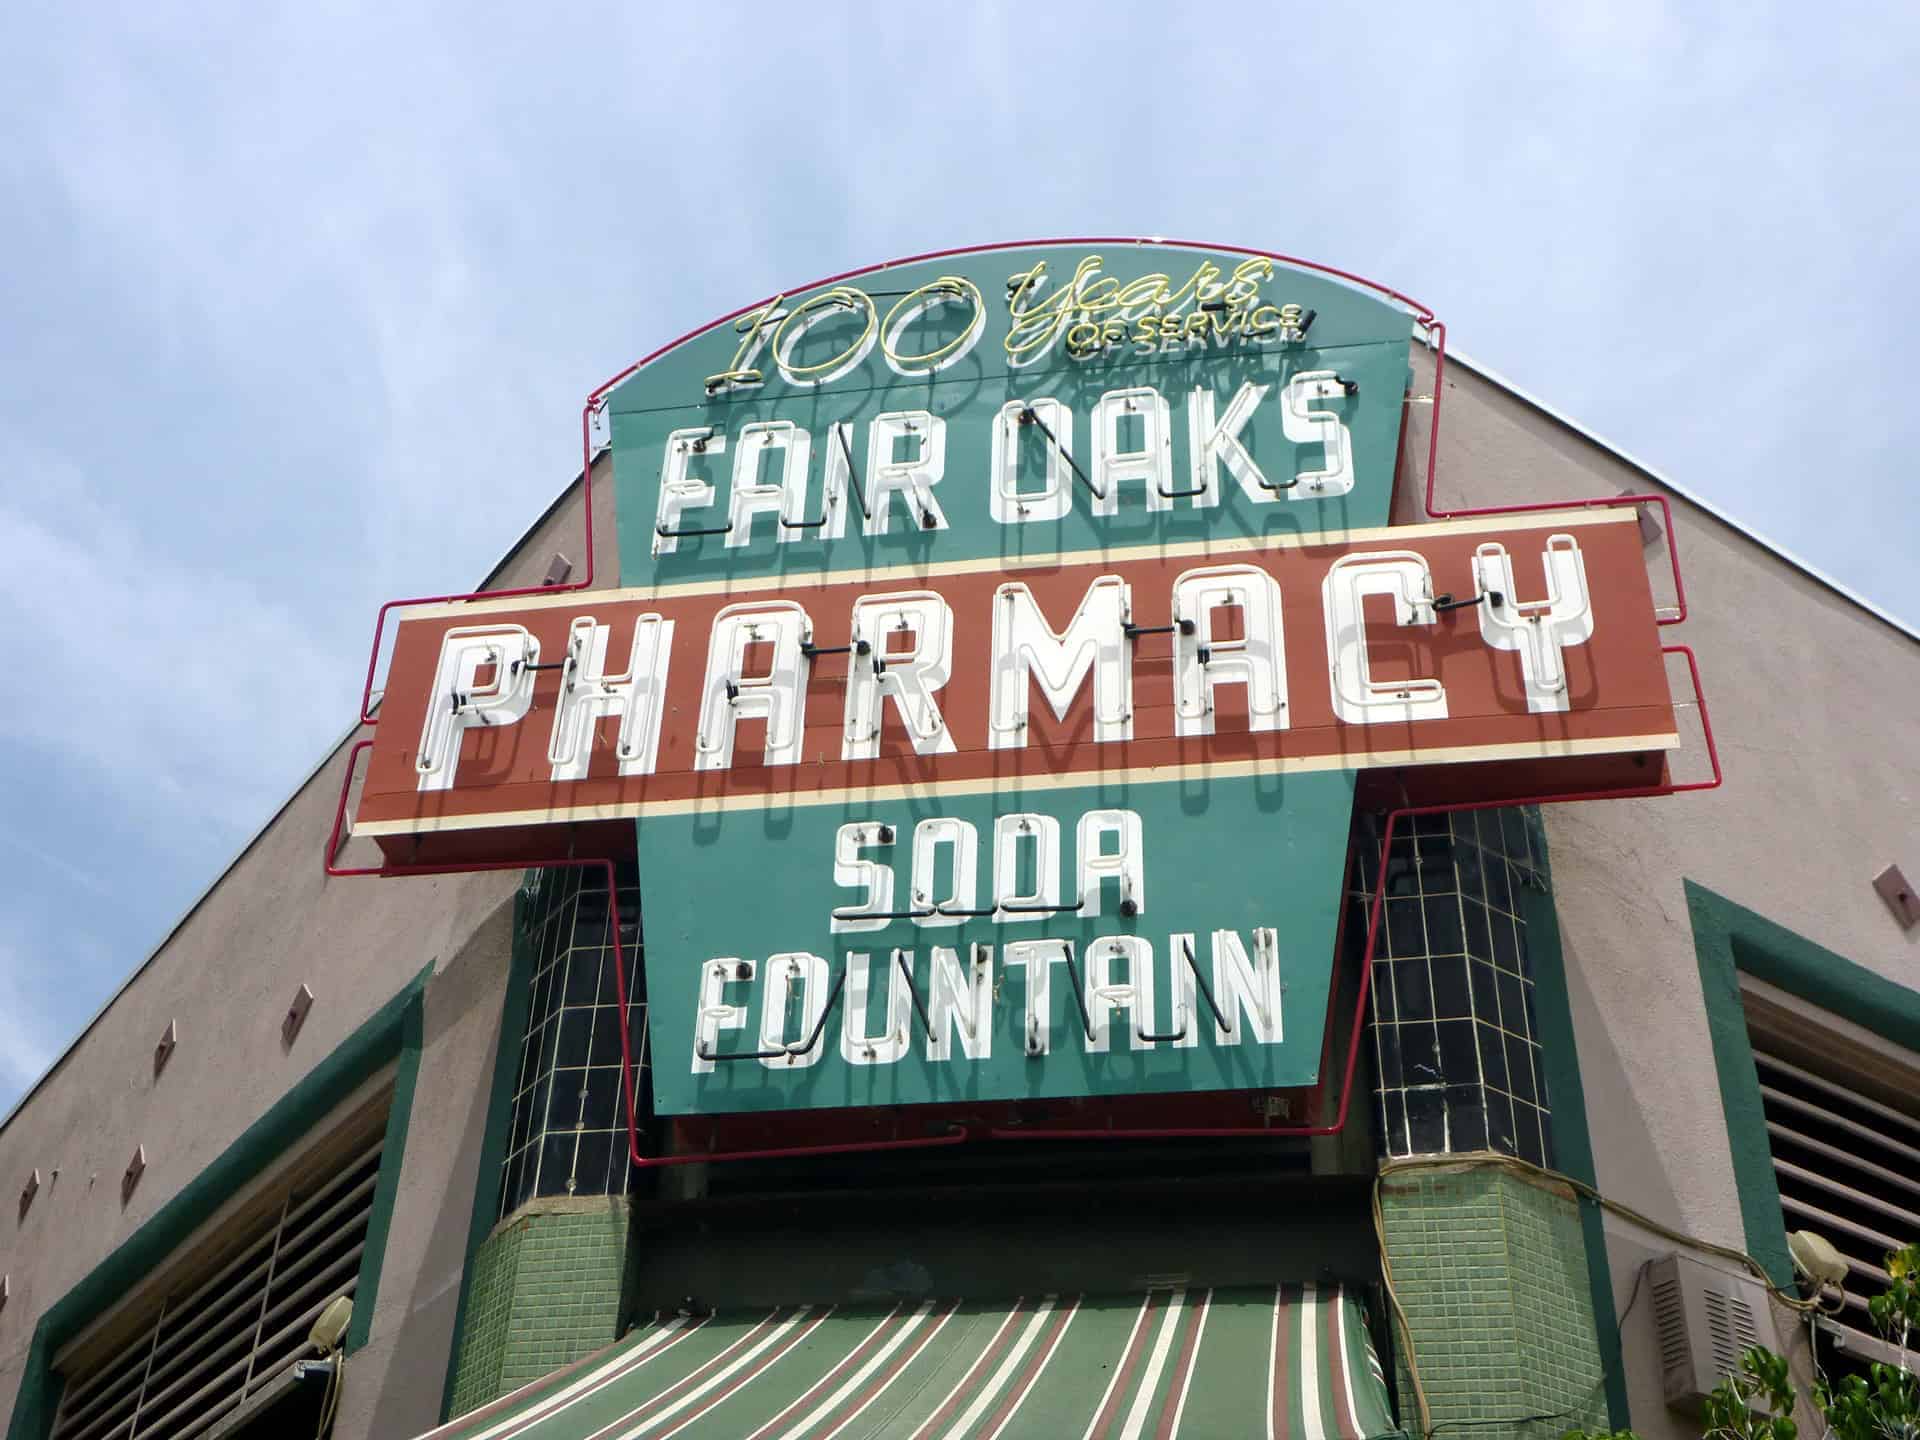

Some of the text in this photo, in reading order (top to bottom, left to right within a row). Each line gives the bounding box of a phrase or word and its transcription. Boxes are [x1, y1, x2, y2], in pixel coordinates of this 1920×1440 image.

[704, 275, 987, 396] 100
[1066, 303, 1308, 361] OF SERVICE
[651, 370, 1361, 557] FAIR OAKS
[414, 532, 1595, 793] PHARMACY
[829, 808, 1146, 934] SODA
[690, 927, 1285, 1075] FOUNTAIN
